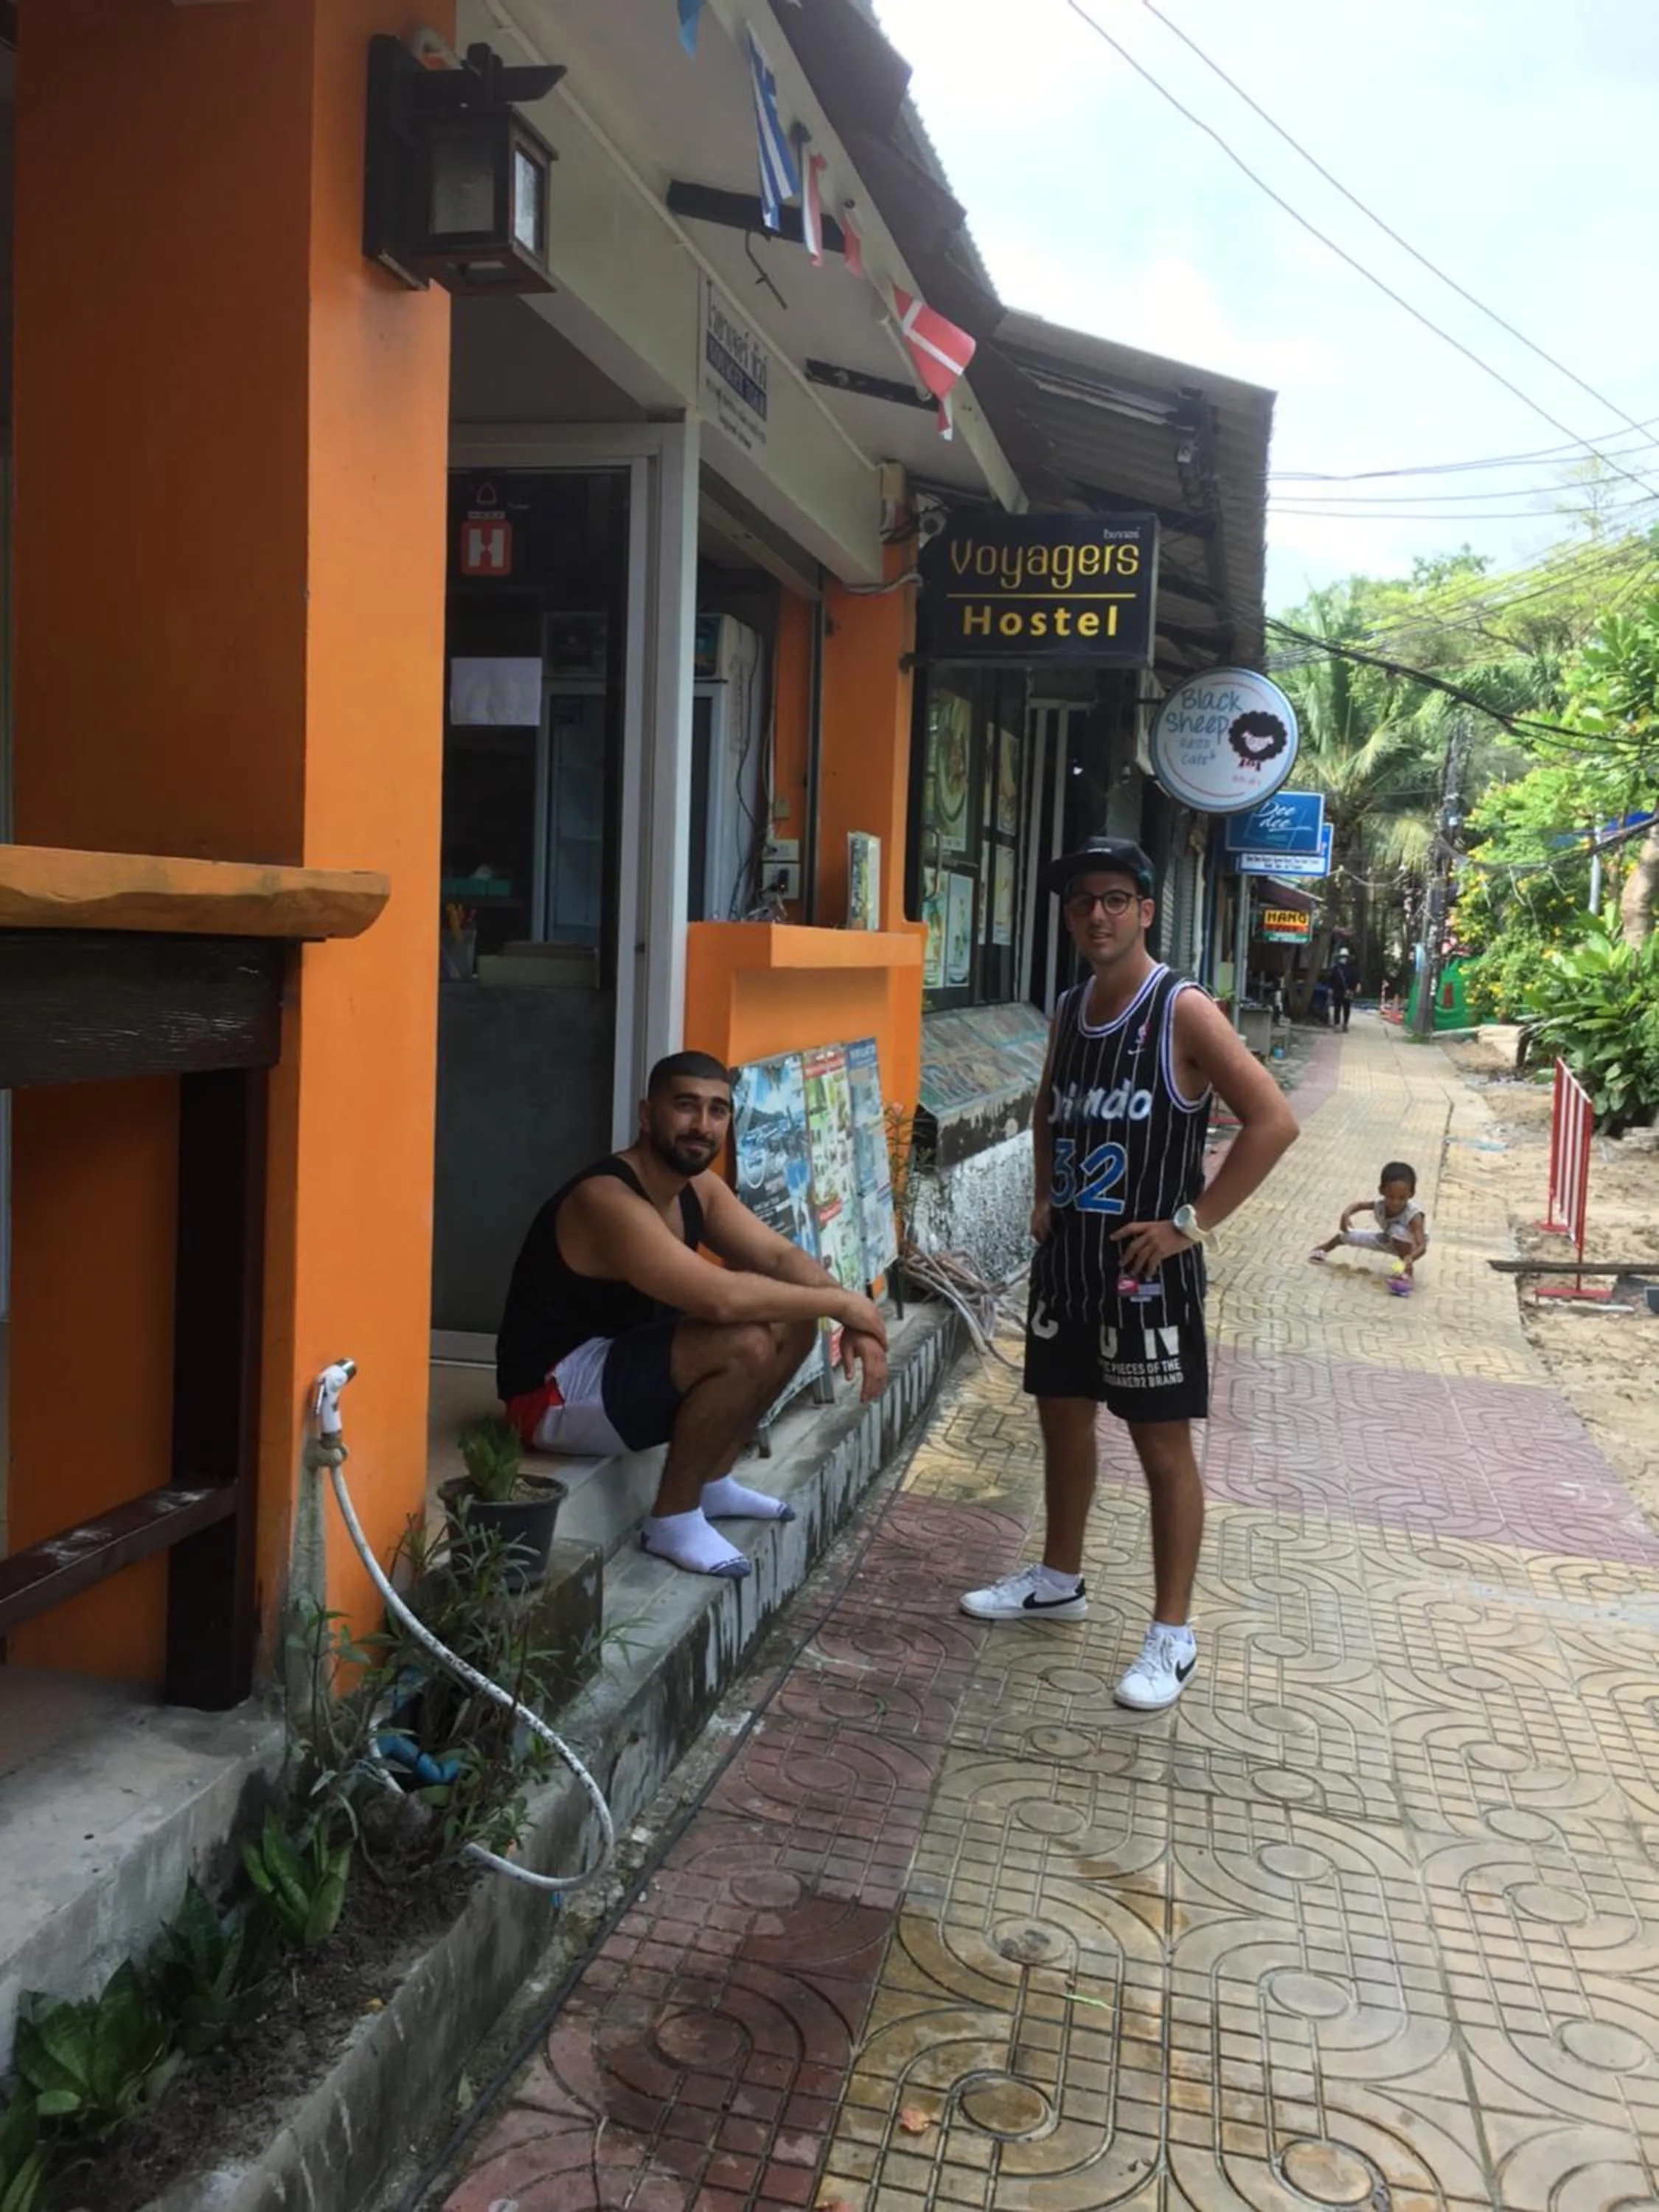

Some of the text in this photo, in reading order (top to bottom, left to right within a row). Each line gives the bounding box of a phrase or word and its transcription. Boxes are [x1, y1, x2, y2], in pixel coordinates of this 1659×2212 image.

[950, 539, 1140, 589] Voyagers
[962, 605, 1119, 636] Hostel
[1180, 686, 1242, 712] Black
[1166, 712, 1229, 745] Sheep
[1050, 1137, 1127, 1214] 32
[1147, 1361, 1161, 1374] OF
[1161, 1357, 1181, 1372] THE
[1147, 1371, 1183, 1388] BRAND
